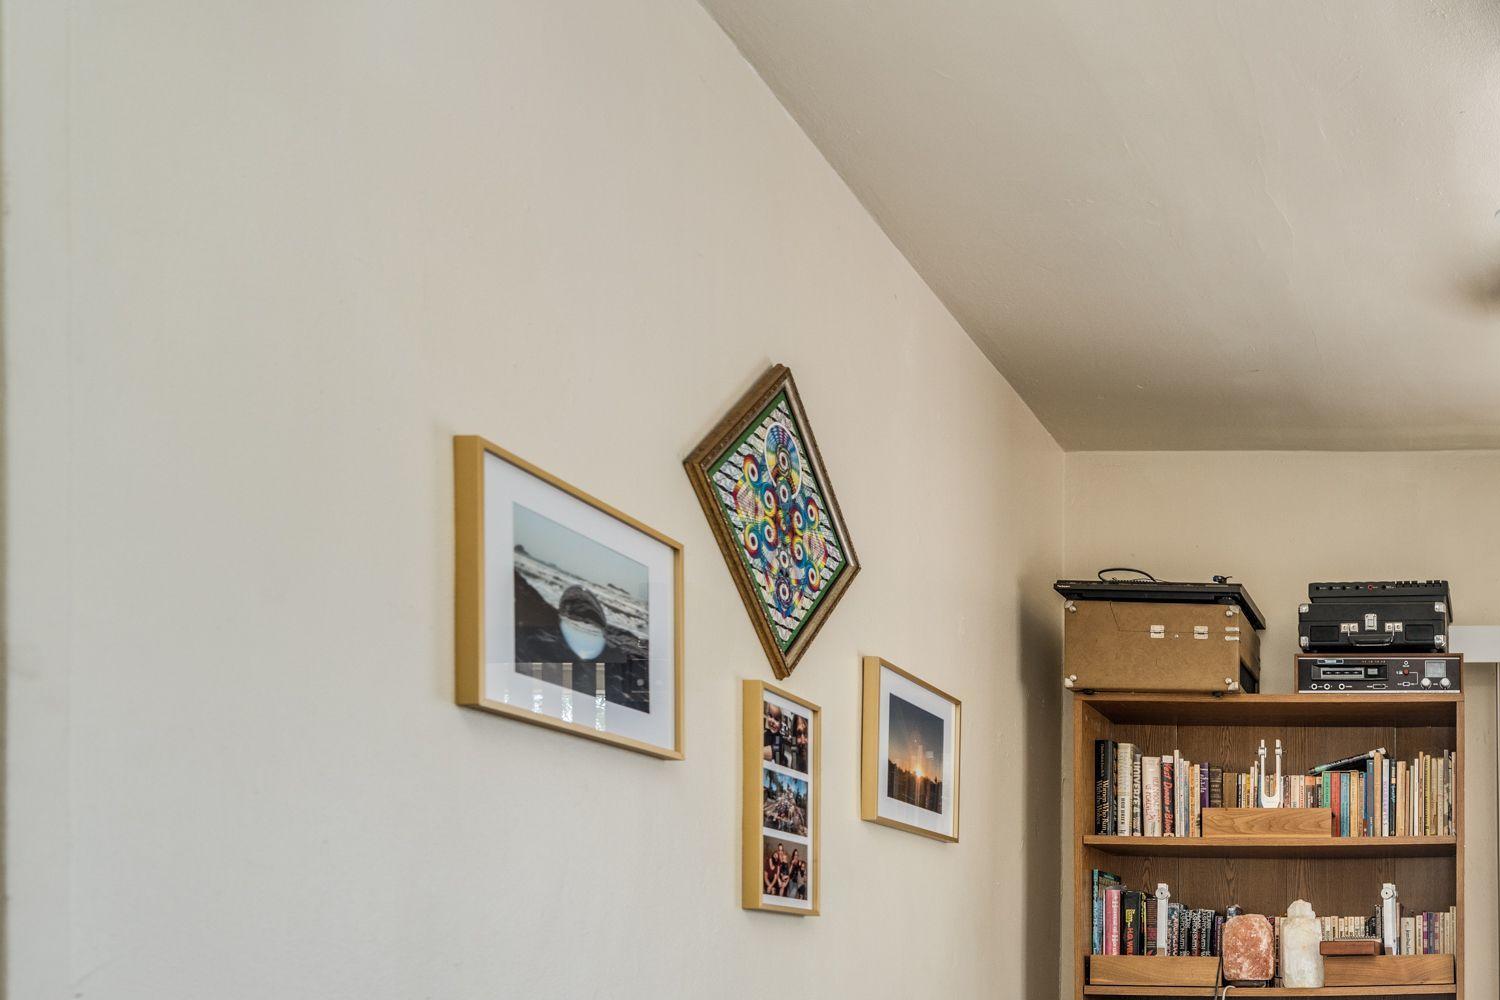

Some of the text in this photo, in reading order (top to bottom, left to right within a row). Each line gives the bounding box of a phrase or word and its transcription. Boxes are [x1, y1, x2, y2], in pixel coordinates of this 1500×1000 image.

[1102, 780, 1110, 802] Women
[1133, 761, 1141, 805] UNIVERSE
[1102, 803, 1110, 817] Who
[1102, 818, 1110, 831] Run
